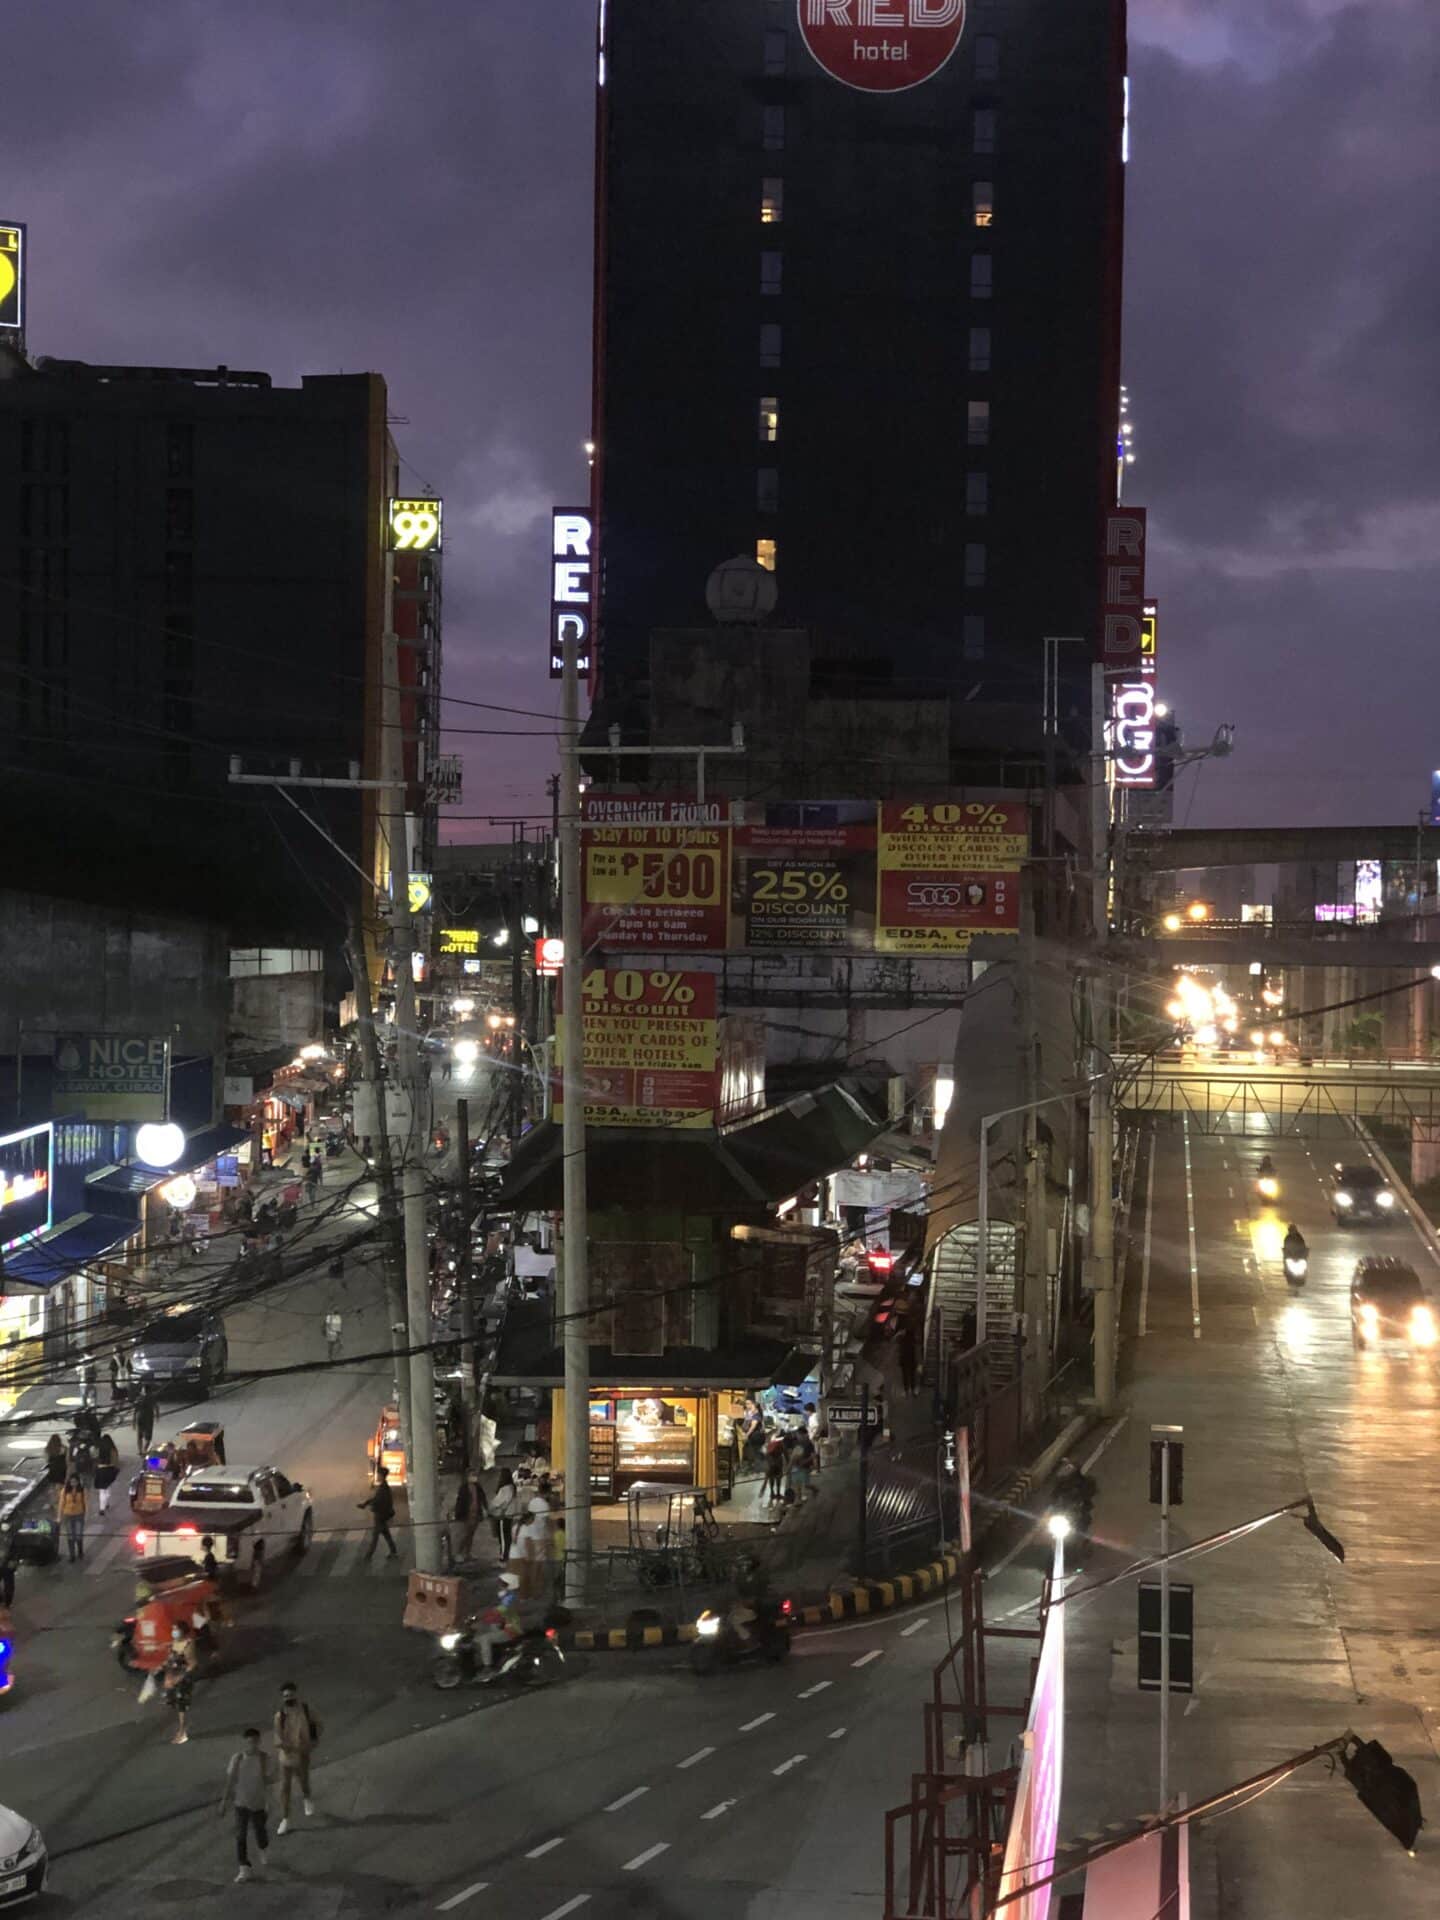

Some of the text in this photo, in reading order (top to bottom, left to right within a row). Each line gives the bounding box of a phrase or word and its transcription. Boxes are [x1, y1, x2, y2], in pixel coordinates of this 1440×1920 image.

[853, 40, 907, 60] hotel
[393, 511, 438, 549] 99
[588, 801, 664, 821] OVERNIGHT
[901, 803, 1008, 824] 40%
[592, 827, 719, 845] Stay for 10 Hours
[752, 869, 848, 900] 25%
[655, 906, 704, 918] between
[751, 902, 850, 915] DISCOUNT
[648, 919, 659, 928] to
[642, 931, 654, 941] to
[658, 931, 709, 943] Thursday
[778, 929, 848, 940] DISCOUNT
[582, 969, 696, 1003] 40%
[585, 1001, 689, 1016] Discount
[614, 1019, 640, 1031] YOU
[647, 1020, 706, 1032] PRESENT
[640, 1034, 685, 1047] CARDS
[691, 1035, 709, 1047] OF
[88, 1039, 162, 1064] NICE
[583, 1047, 627, 1060] OTHER
[88, 1065, 162, 1079] HOTEL
